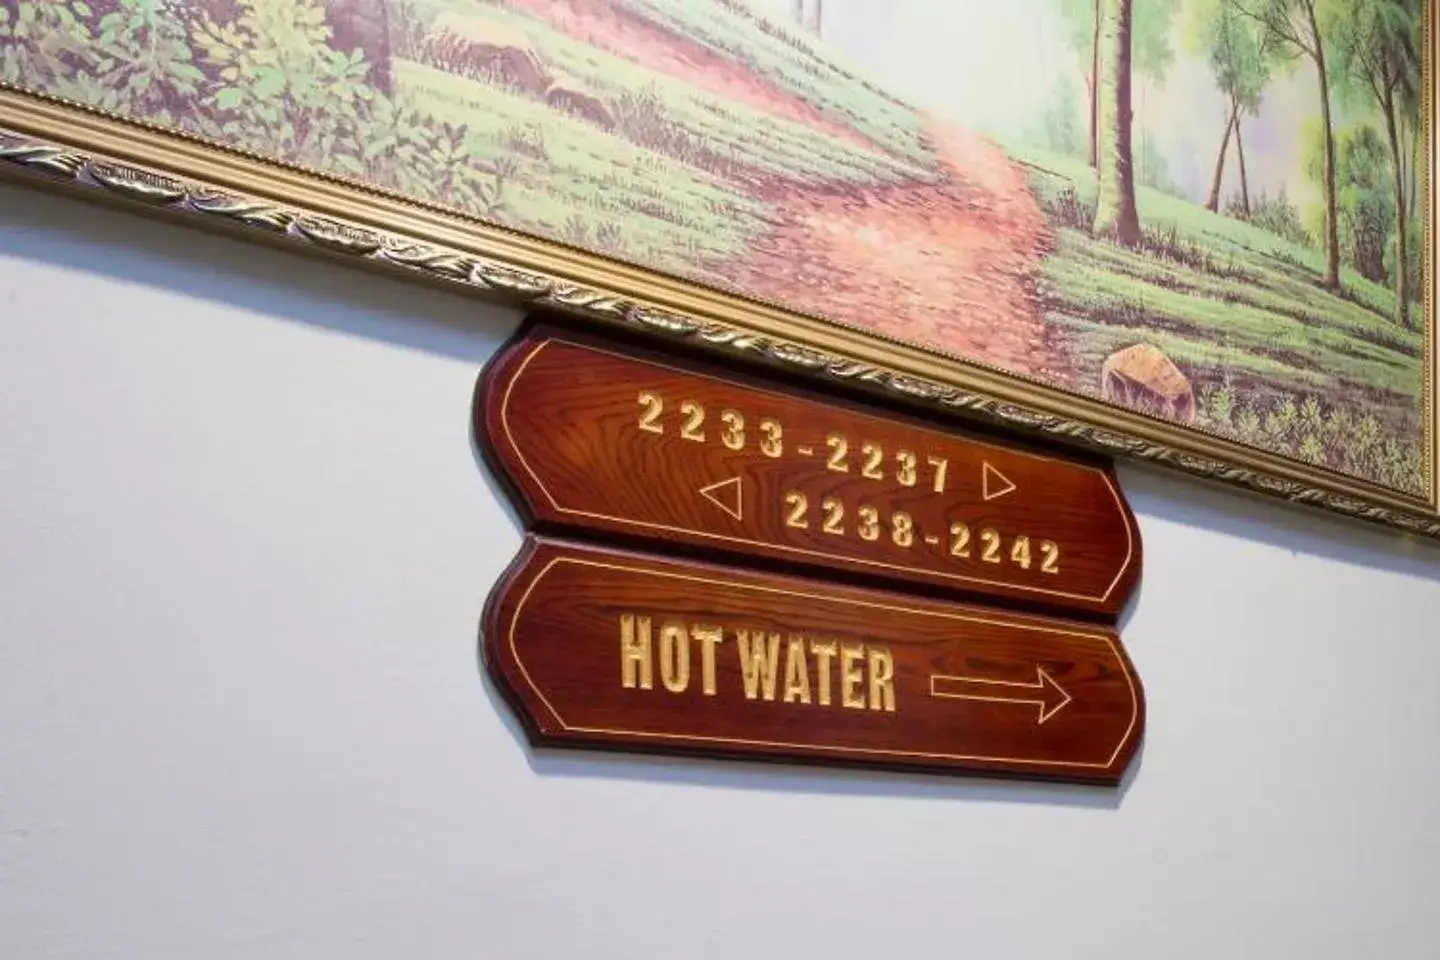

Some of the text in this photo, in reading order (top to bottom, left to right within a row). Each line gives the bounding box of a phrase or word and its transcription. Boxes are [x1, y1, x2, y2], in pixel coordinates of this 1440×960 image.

[636, 391, 950, 493] 2233-2237
[784, 490, 1061, 575] 2238-2242
[618, 614, 896, 713] HOT WATER
